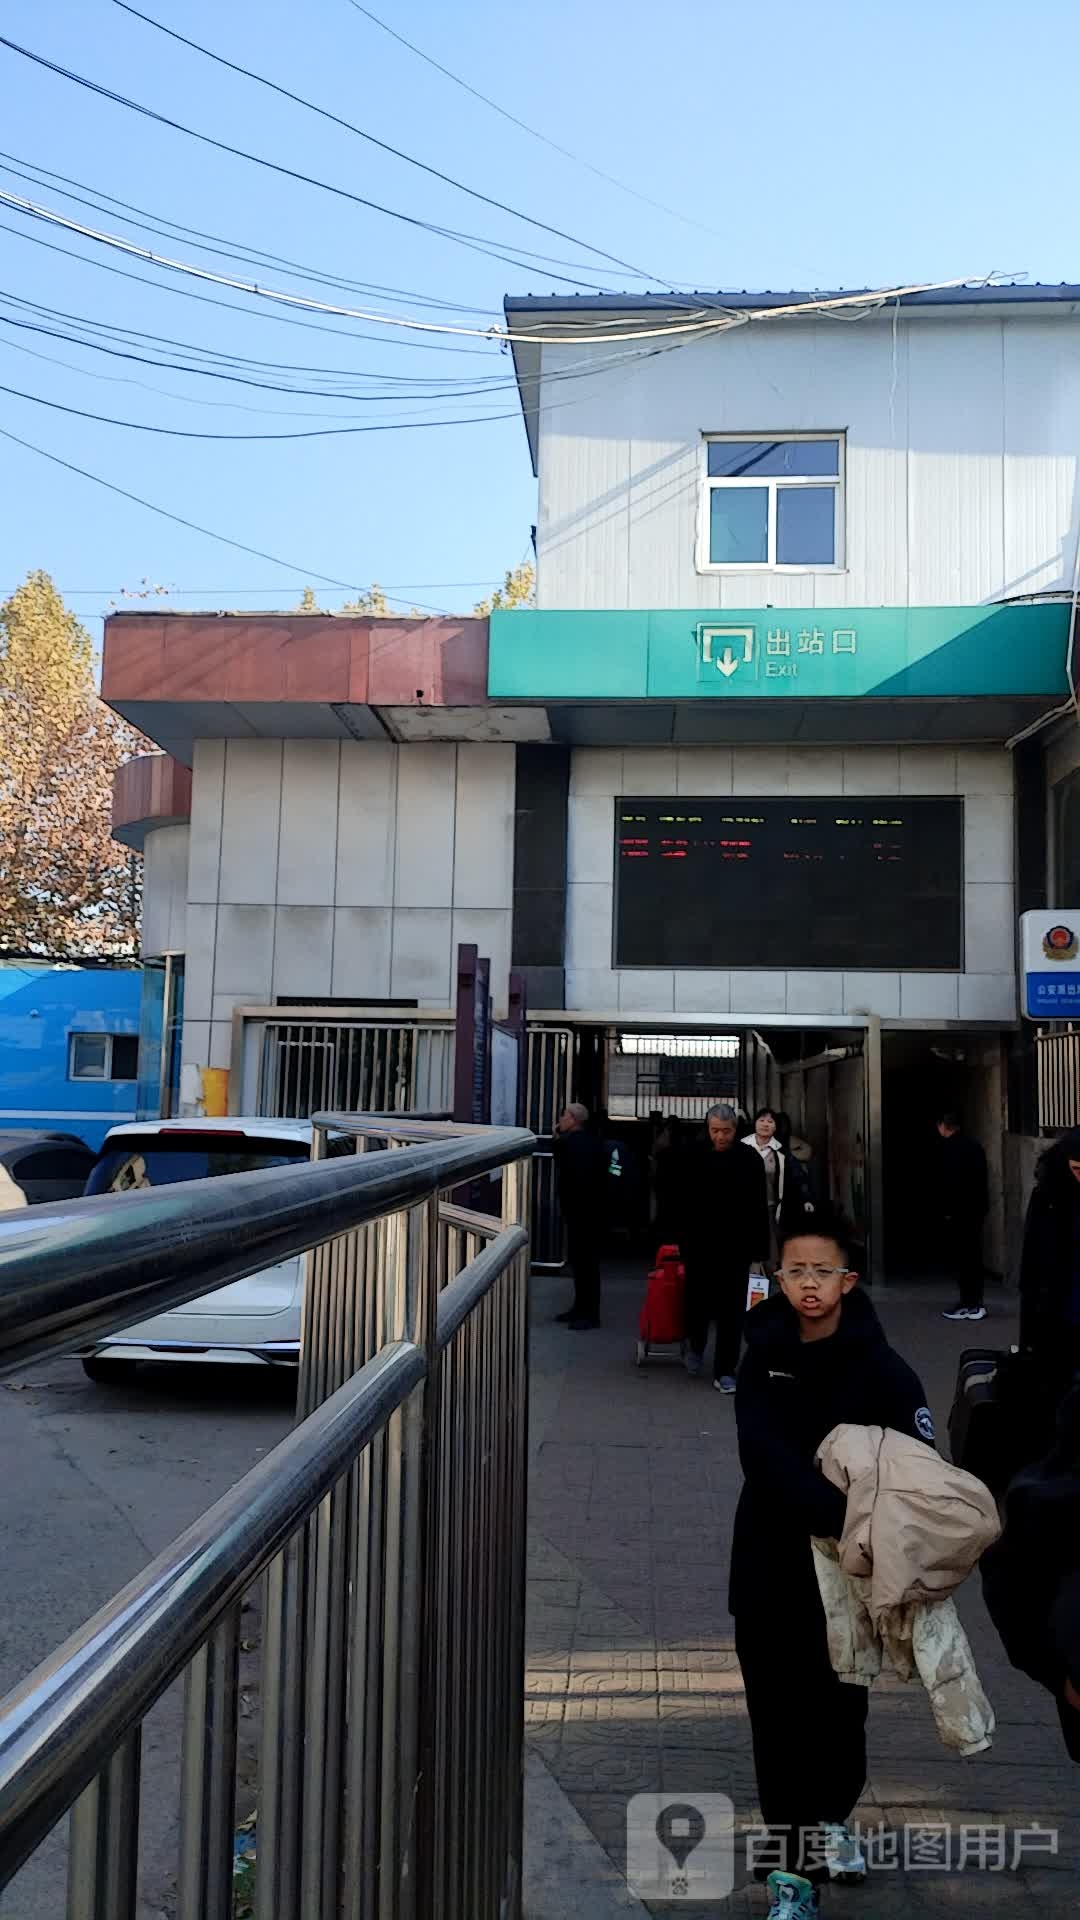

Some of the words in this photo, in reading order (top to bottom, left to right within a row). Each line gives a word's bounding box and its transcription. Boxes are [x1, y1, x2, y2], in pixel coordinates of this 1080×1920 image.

[767, 627, 857, 656] 出站口
[765, 661, 798, 677] Exit
